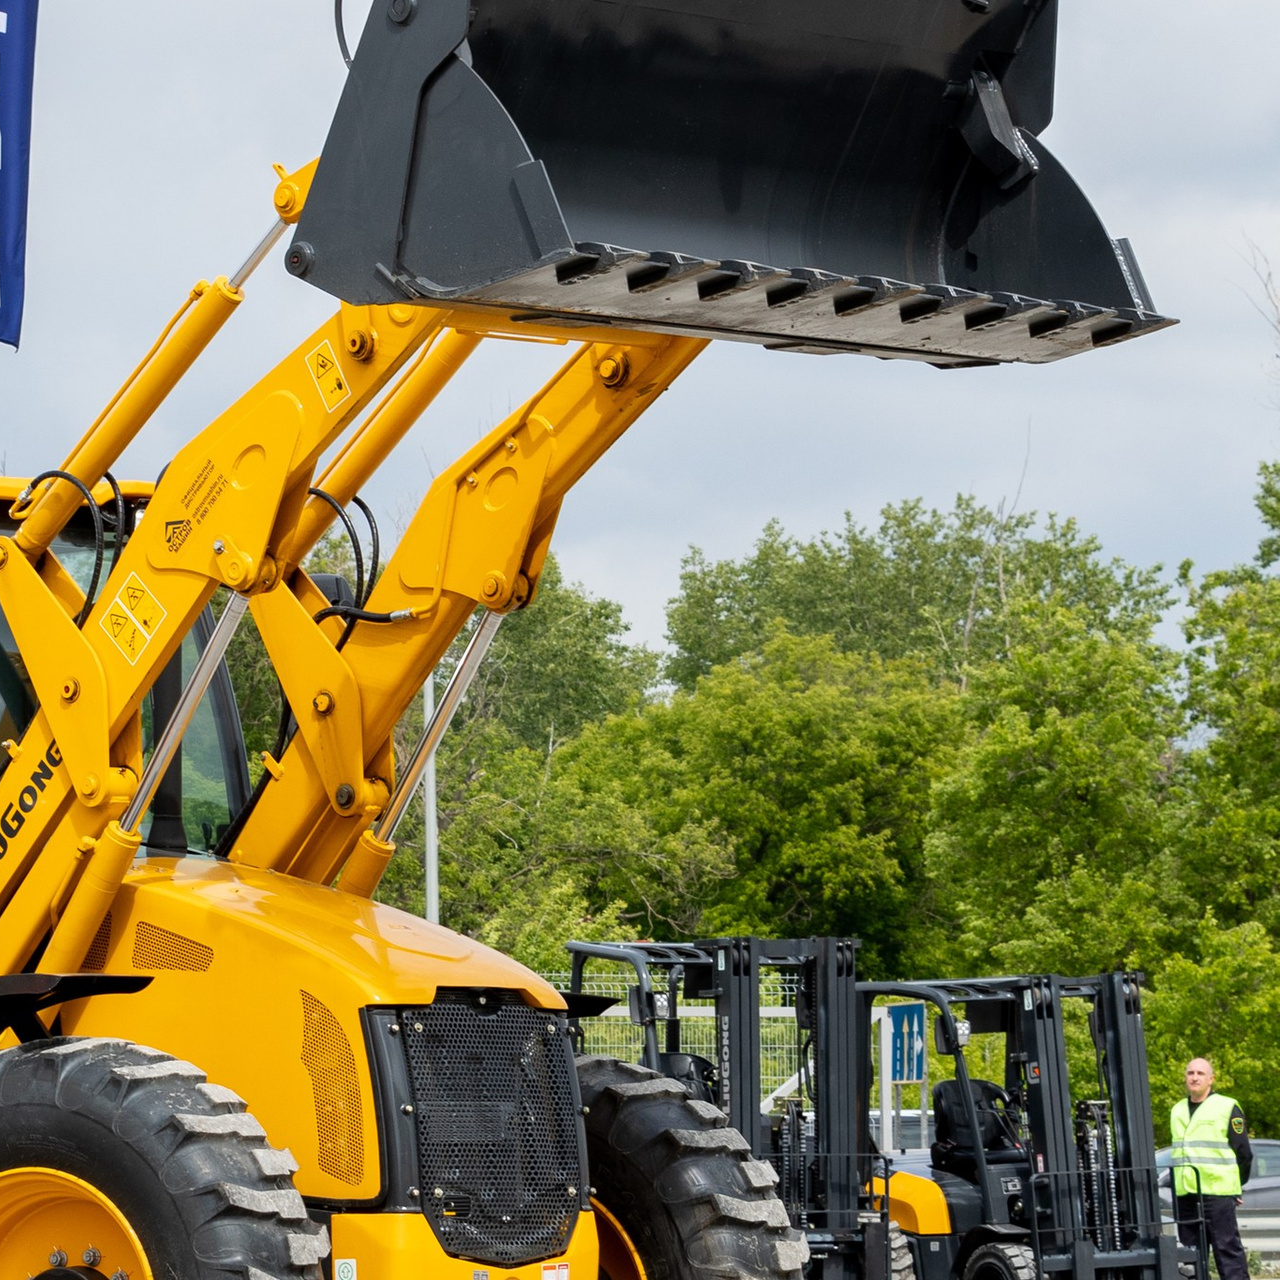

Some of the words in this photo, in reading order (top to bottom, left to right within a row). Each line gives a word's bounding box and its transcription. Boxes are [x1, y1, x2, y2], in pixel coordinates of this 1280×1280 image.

[168, 519, 192, 552] ОСТРОВ
[173, 527, 193, 554] МАШИН
[722, 1015, 730, 1114] LIUGONG
